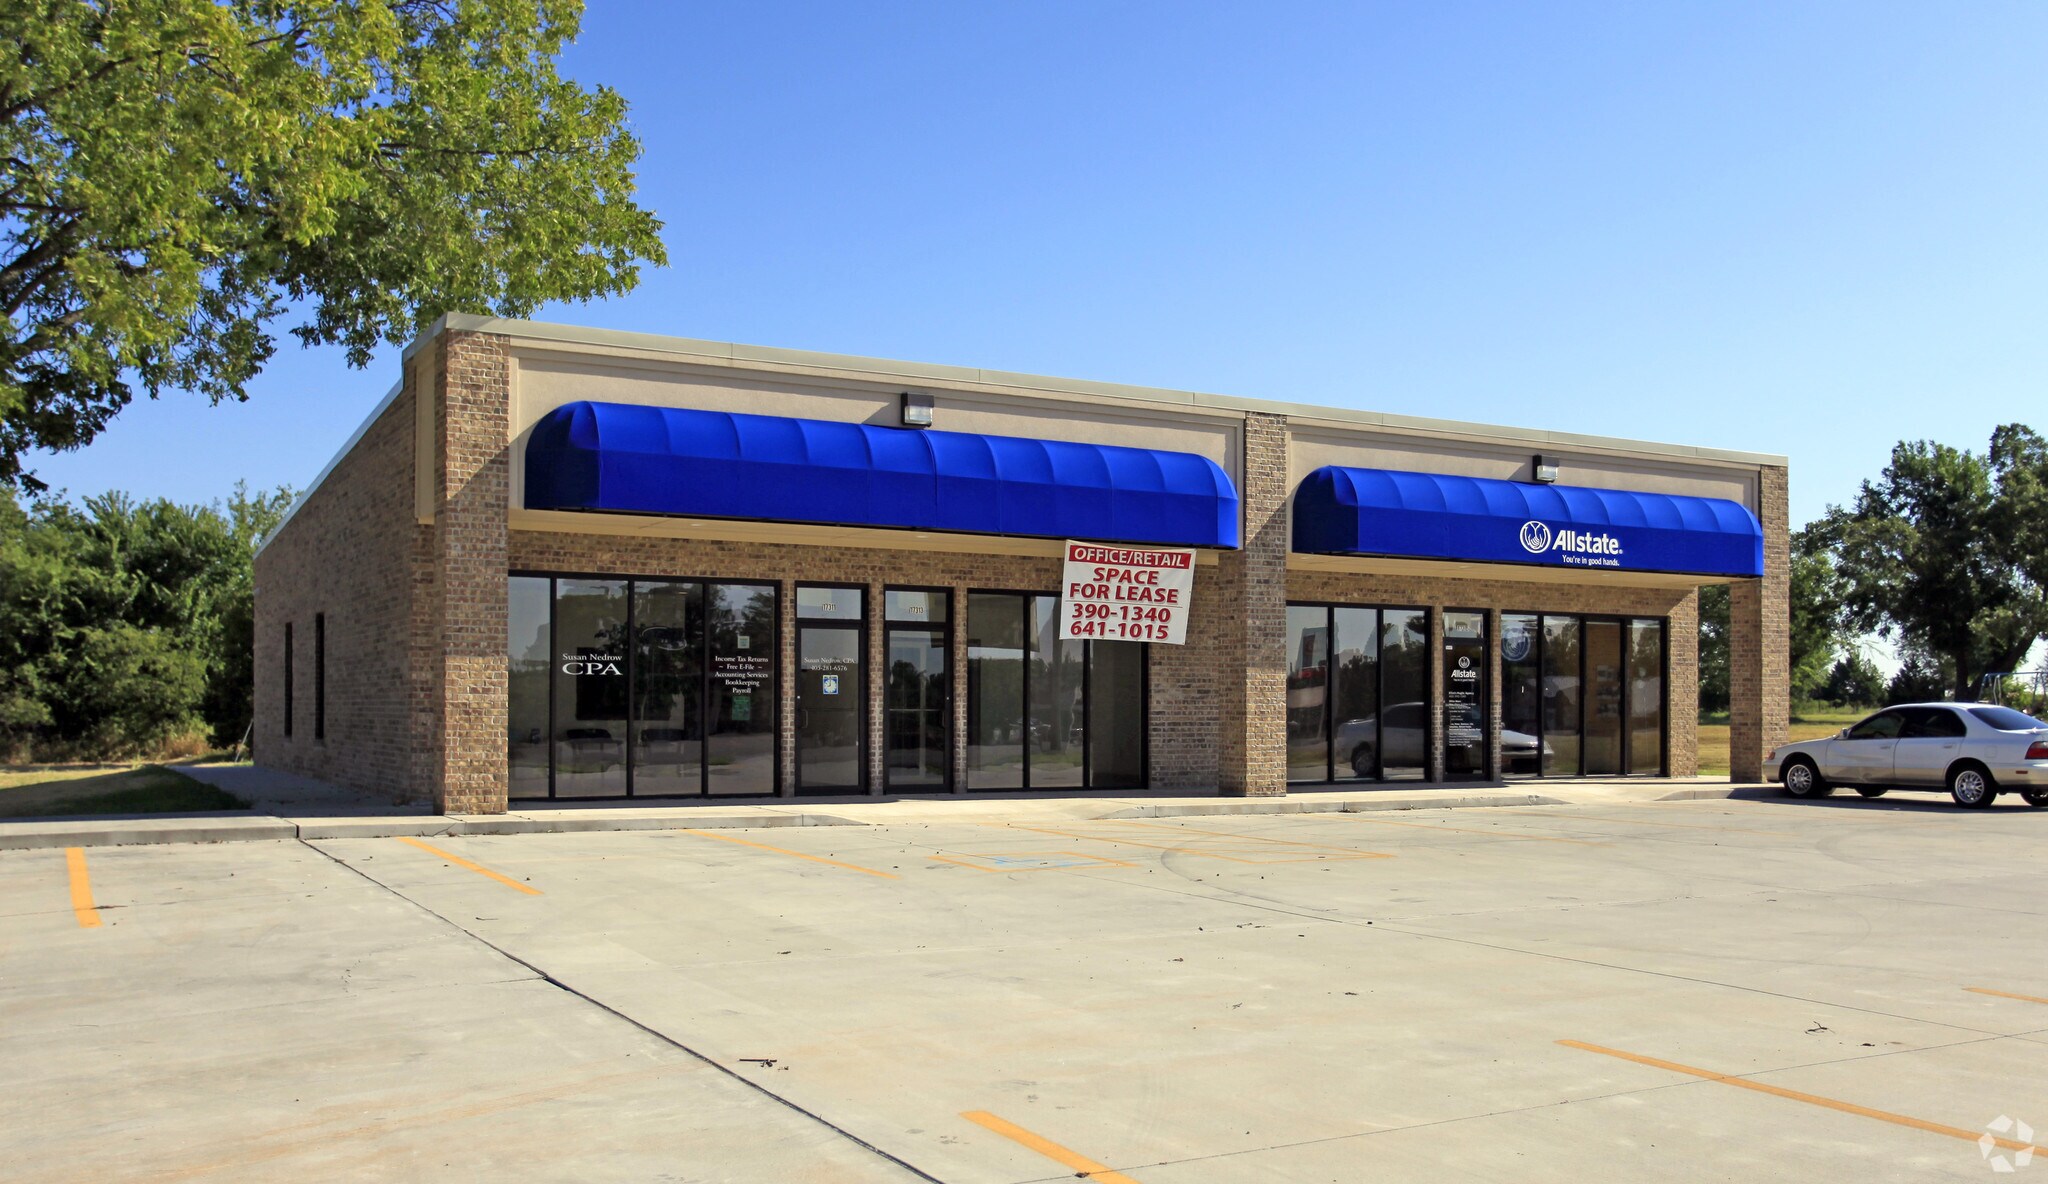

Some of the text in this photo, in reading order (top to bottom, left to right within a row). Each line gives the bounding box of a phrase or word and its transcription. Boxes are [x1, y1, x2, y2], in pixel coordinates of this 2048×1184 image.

[1552, 530, 1620, 555] Allstate
[1074, 547, 1185, 567] OFFICE/RETAIL
[1562, 554, 1620, 566] You're in good hands.
[1093, 567, 1159, 585] SPACE
[1069, 582, 1178, 604] FOR LEASE
[1072, 603, 1171, 623] 390-1340
[1070, 620, 1169, 640] 641-1015
[562, 653, 623, 661] Susan Nedrow
[562, 662, 624, 676] CPA
[1451, 670, 1476, 678] Allstate
[725, 679, 760, 687] Bookkeeping
[732, 687, 752, 695] Payroll
